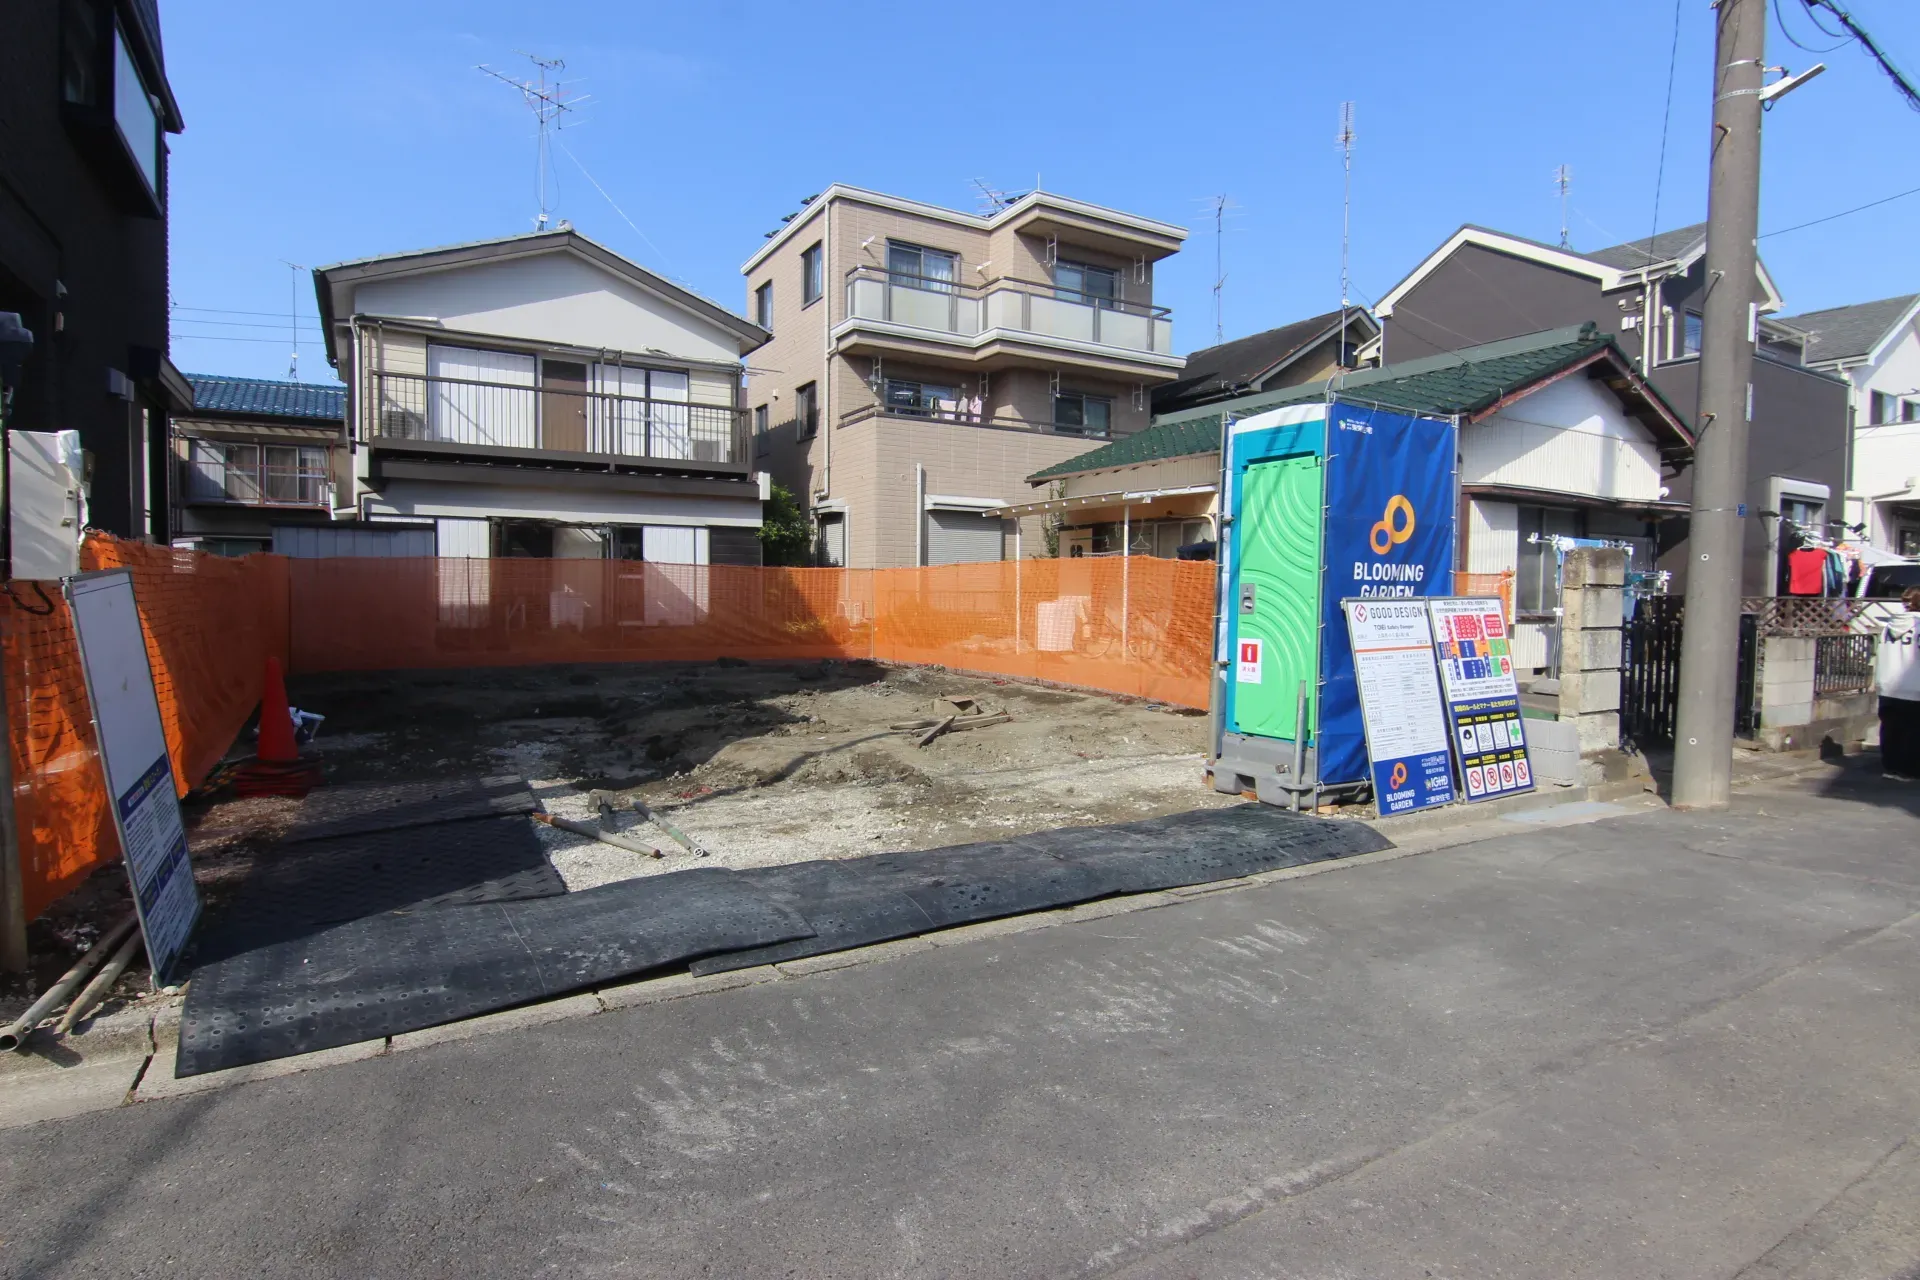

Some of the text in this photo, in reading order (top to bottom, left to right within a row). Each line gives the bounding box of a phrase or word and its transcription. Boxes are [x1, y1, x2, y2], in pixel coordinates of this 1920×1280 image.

[1354, 562, 1424, 581] BLOOMING
[1361, 584, 1414, 597] GARDEN
[1370, 607, 1392, 619] GOOD
[1394, 606, 1423, 618] DESIGN
[1386, 789, 1415, 802] BLOOMING
[1391, 799, 1413, 811] GARDEN
